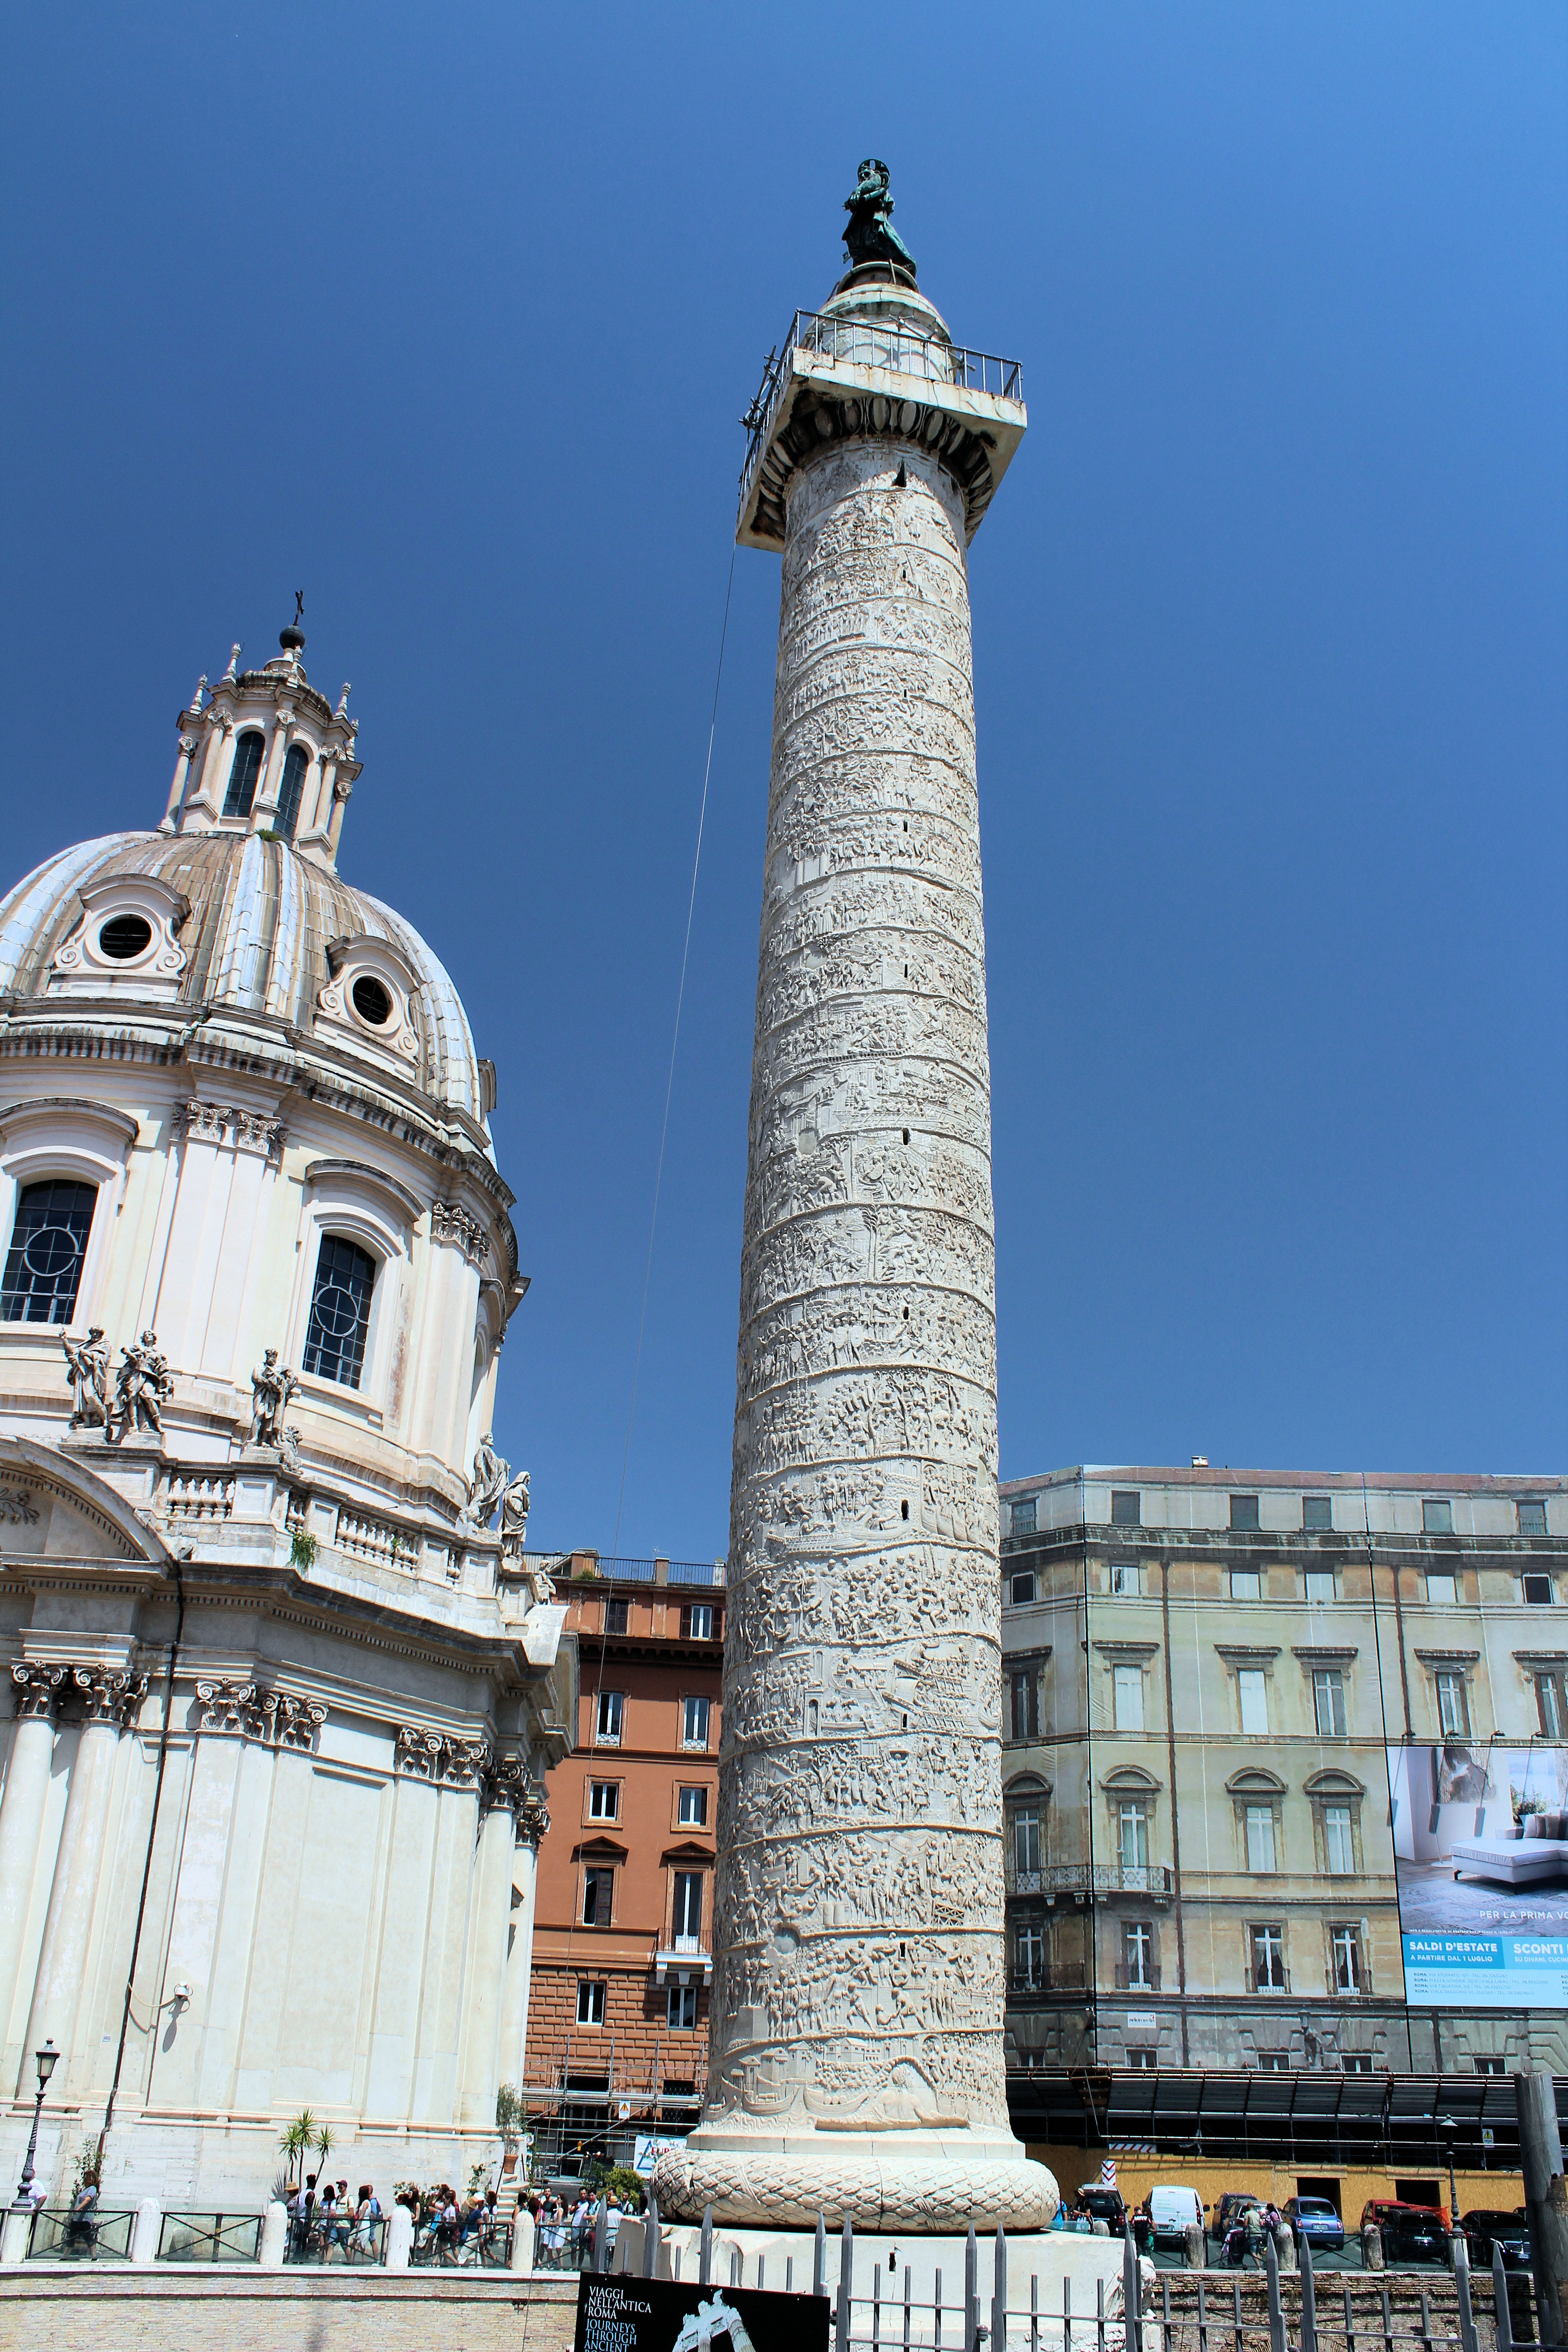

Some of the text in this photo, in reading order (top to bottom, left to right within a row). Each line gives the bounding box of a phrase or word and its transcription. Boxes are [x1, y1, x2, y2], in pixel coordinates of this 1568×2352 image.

[1480, 1910, 1500, 1919] PER
[1503, 1911, 1517, 1919] LA
[1520, 1911, 1553, 1920] PRIMA
[1409, 1941, 1498, 1952] SALDI D'ESTATE
[1513, 1943, 1563, 1954] SCONTI
[589, 2286, 624, 2299] VIAGGI
[588, 2296, 651, 2313] NELL'ANTICA
[588, 2306, 617, 2319] ROMA
[585, 2318, 635, 2334] JOURNEYS
[586, 2329, 637, 2345] THROUGH
[584, 2339, 629, 2352] ANCIENT
